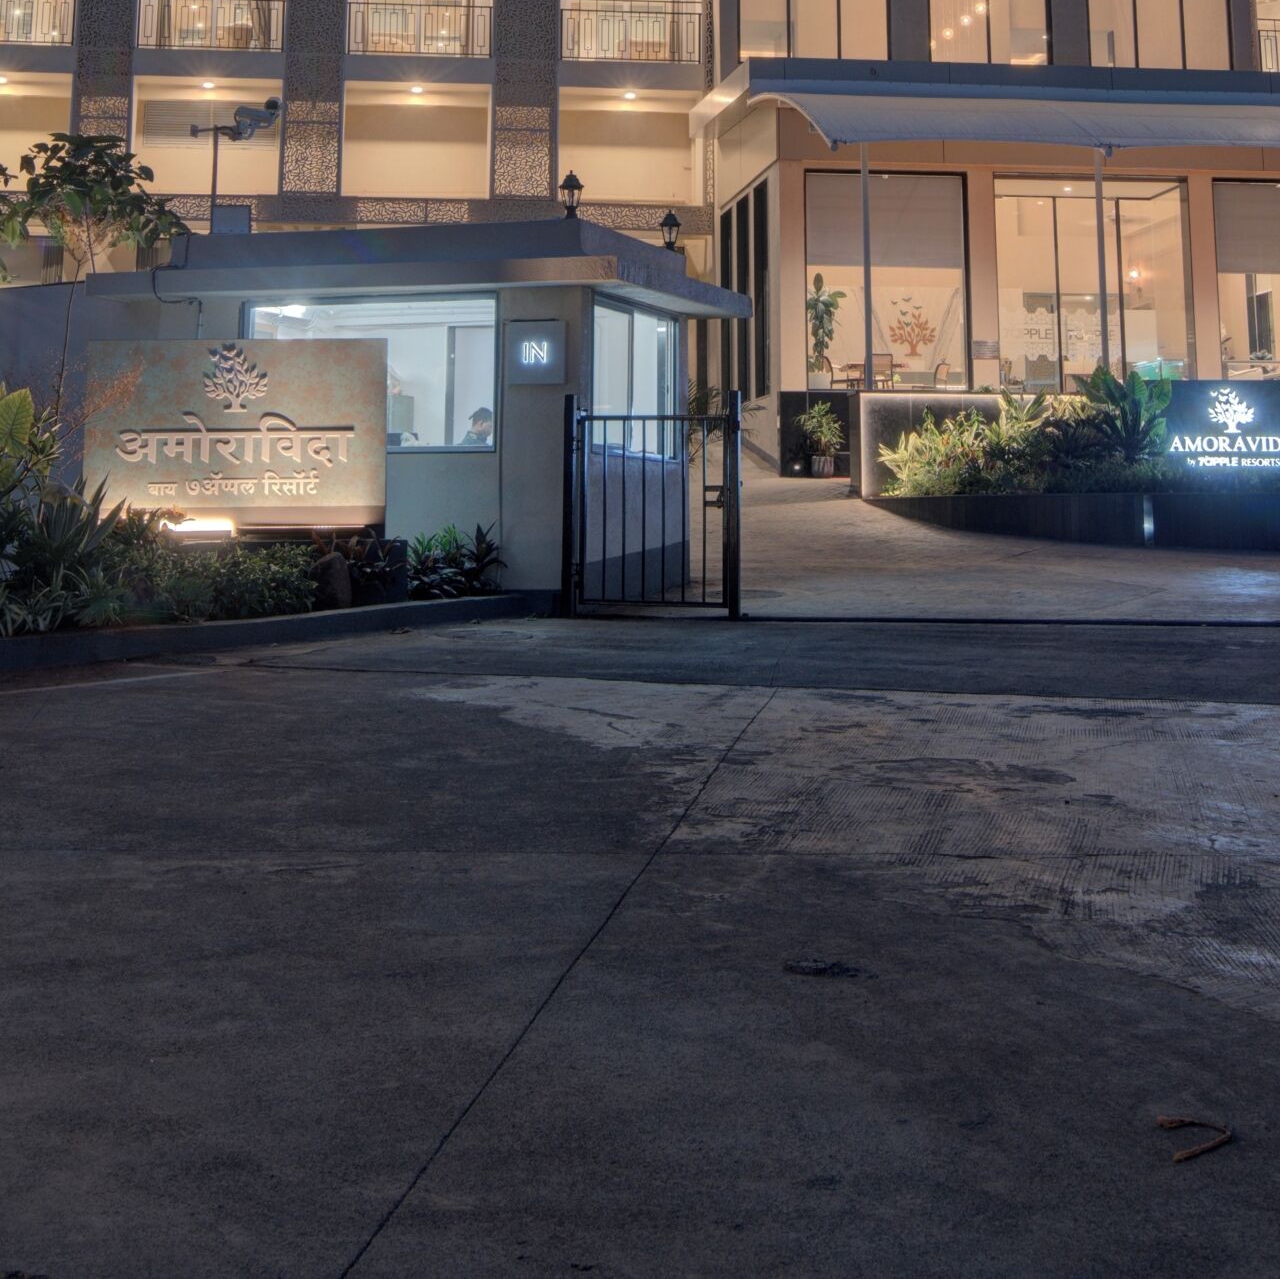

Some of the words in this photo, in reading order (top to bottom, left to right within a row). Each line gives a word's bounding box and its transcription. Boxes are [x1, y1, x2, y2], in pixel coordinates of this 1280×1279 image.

[522, 341, 547, 363] IN
[115, 412, 355, 467] अमोराविदा
[1187, 457, 1196, 467] by
[1241, 457, 1280, 467] RESORTS
[147, 482, 178, 496] बाय
